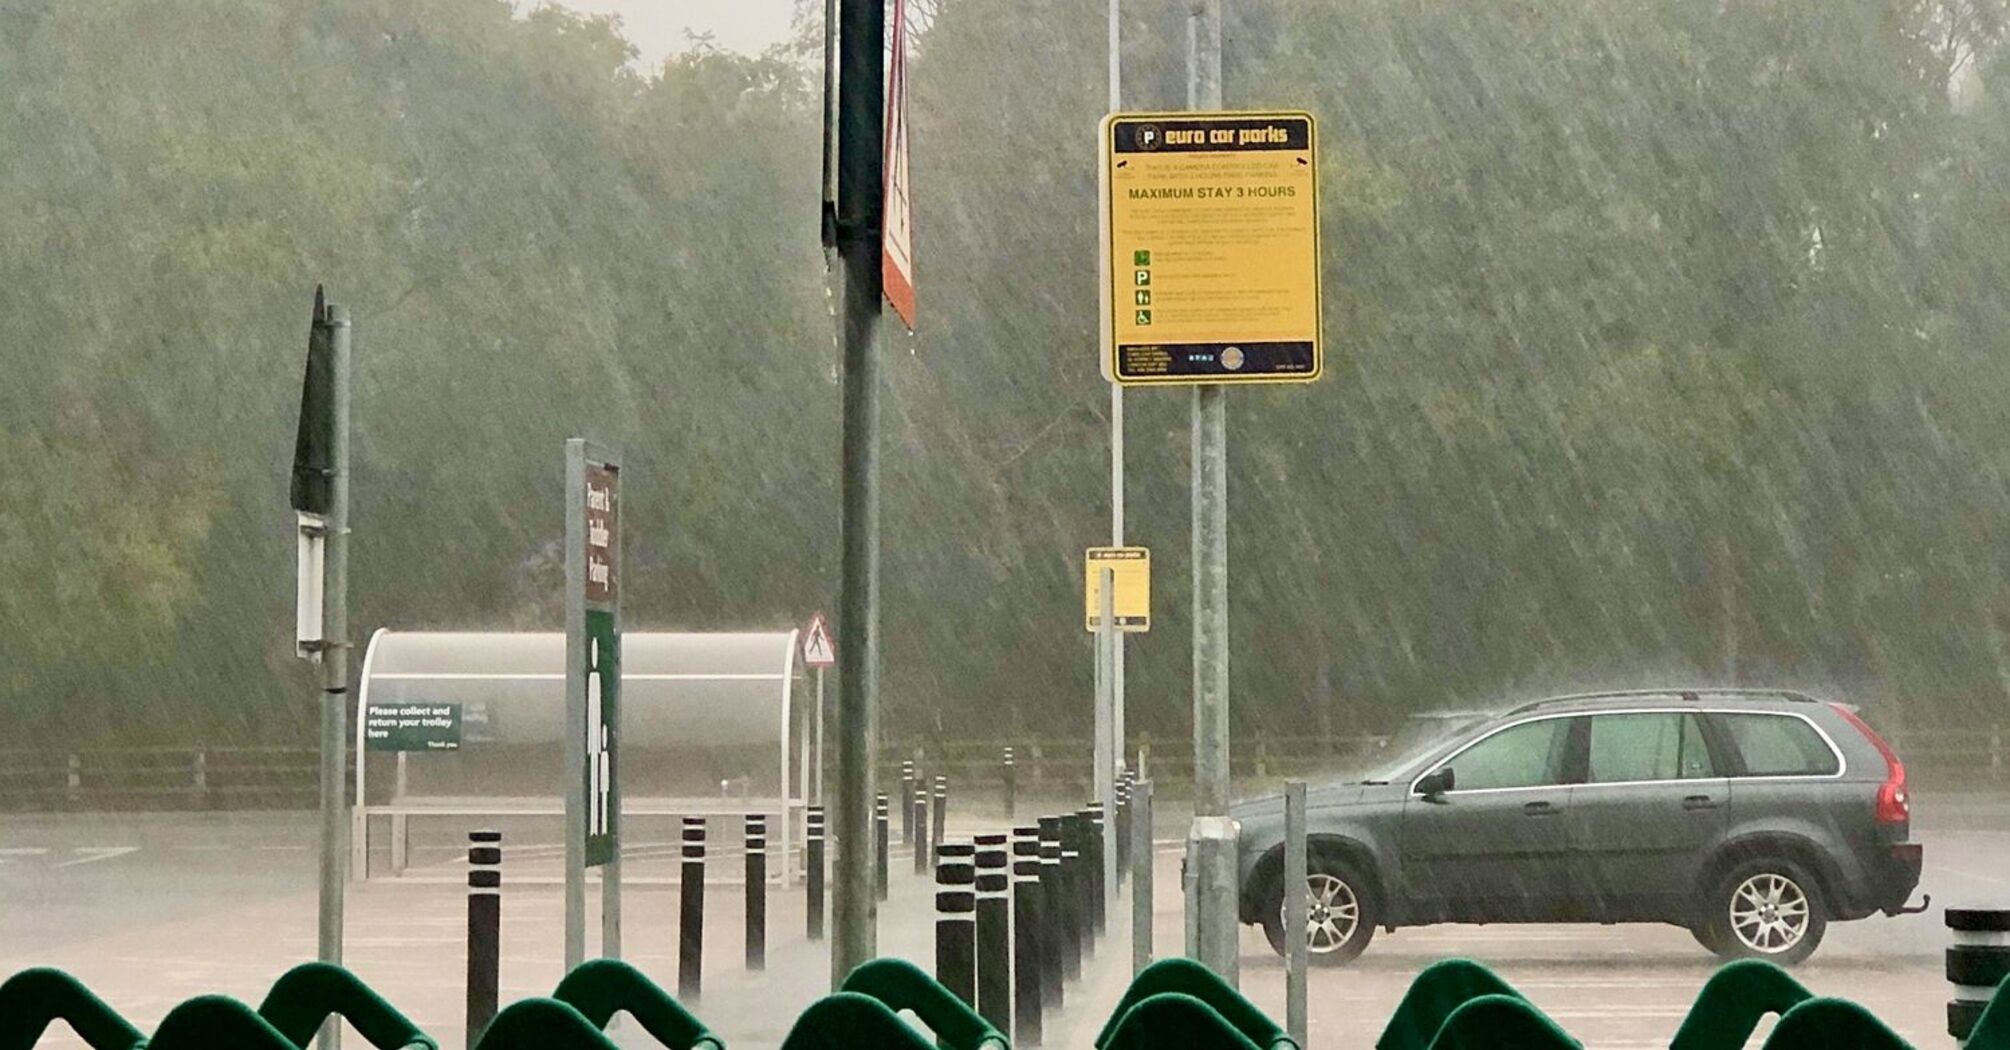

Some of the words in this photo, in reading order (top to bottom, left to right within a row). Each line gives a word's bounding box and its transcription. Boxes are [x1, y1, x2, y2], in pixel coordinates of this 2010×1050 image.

[1144, 131, 1154, 144] P
[1165, 130, 1205, 145] euro
[1210, 129, 1235, 144] car
[1239, 126, 1288, 145] parks
[1128, 188, 1193, 199] MAXIMUM
[1197, 187, 1232, 199] STAY
[1237, 187, 1244, 198] 3
[1248, 186, 1296, 198] HOURS
[1137, 271, 1148, 285] P
[369, 706, 398, 716] Please
[400, 706, 430, 716] collect
[432, 706, 450, 716] and
[368, 719, 398, 728] return
[398, 719, 420, 729] your
[422, 717, 452, 729] trolley
[368, 728, 389, 738] here
